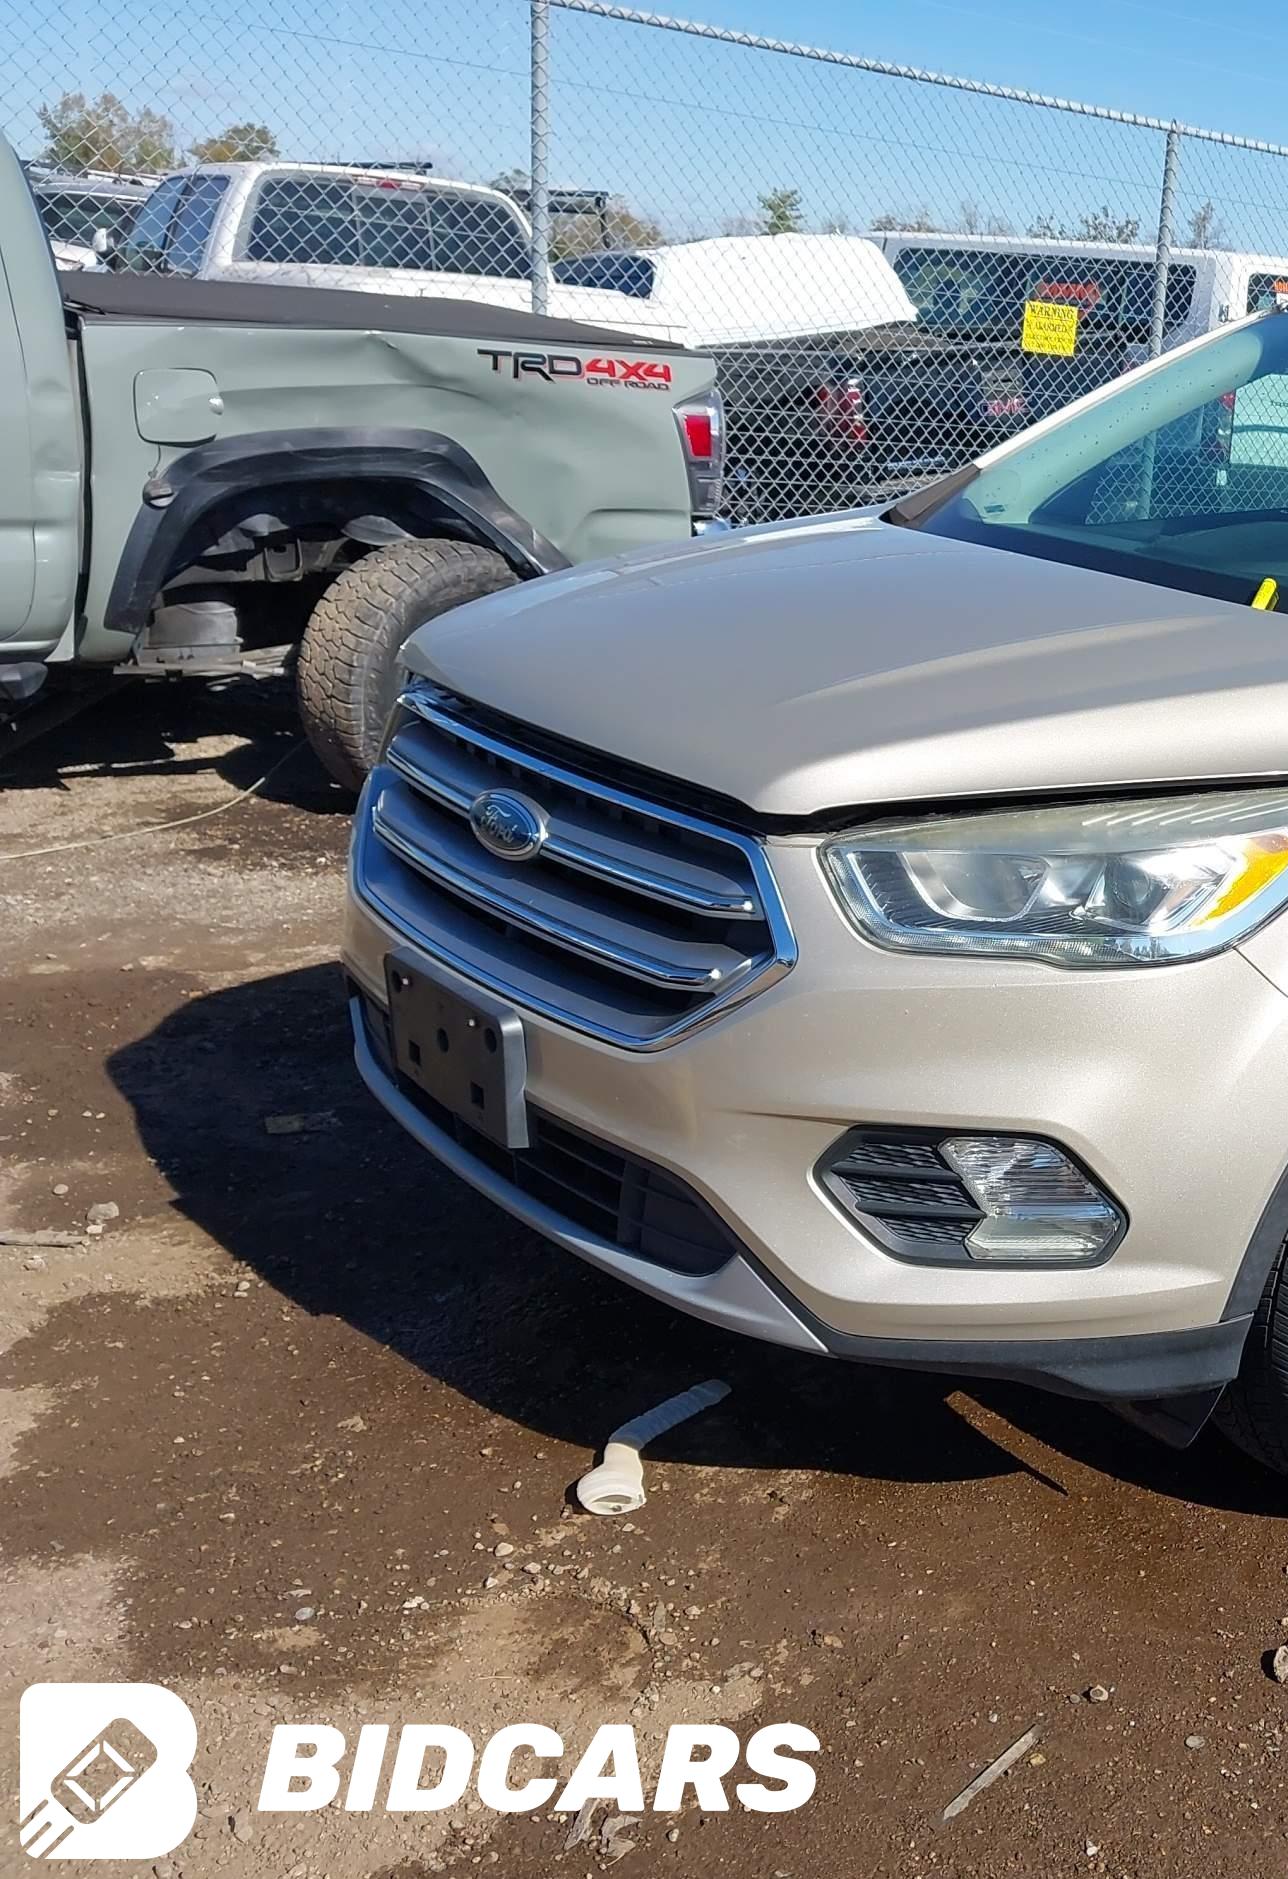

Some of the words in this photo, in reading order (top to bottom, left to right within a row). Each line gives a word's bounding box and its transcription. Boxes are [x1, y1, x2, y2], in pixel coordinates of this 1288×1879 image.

[1030, 304, 1074, 319] WARNING
[477, 348, 583, 384] TRD
[586, 377, 620, 386] OFF
[624, 380, 670, 391] ROAD
[481, 804, 519, 843] Ford
